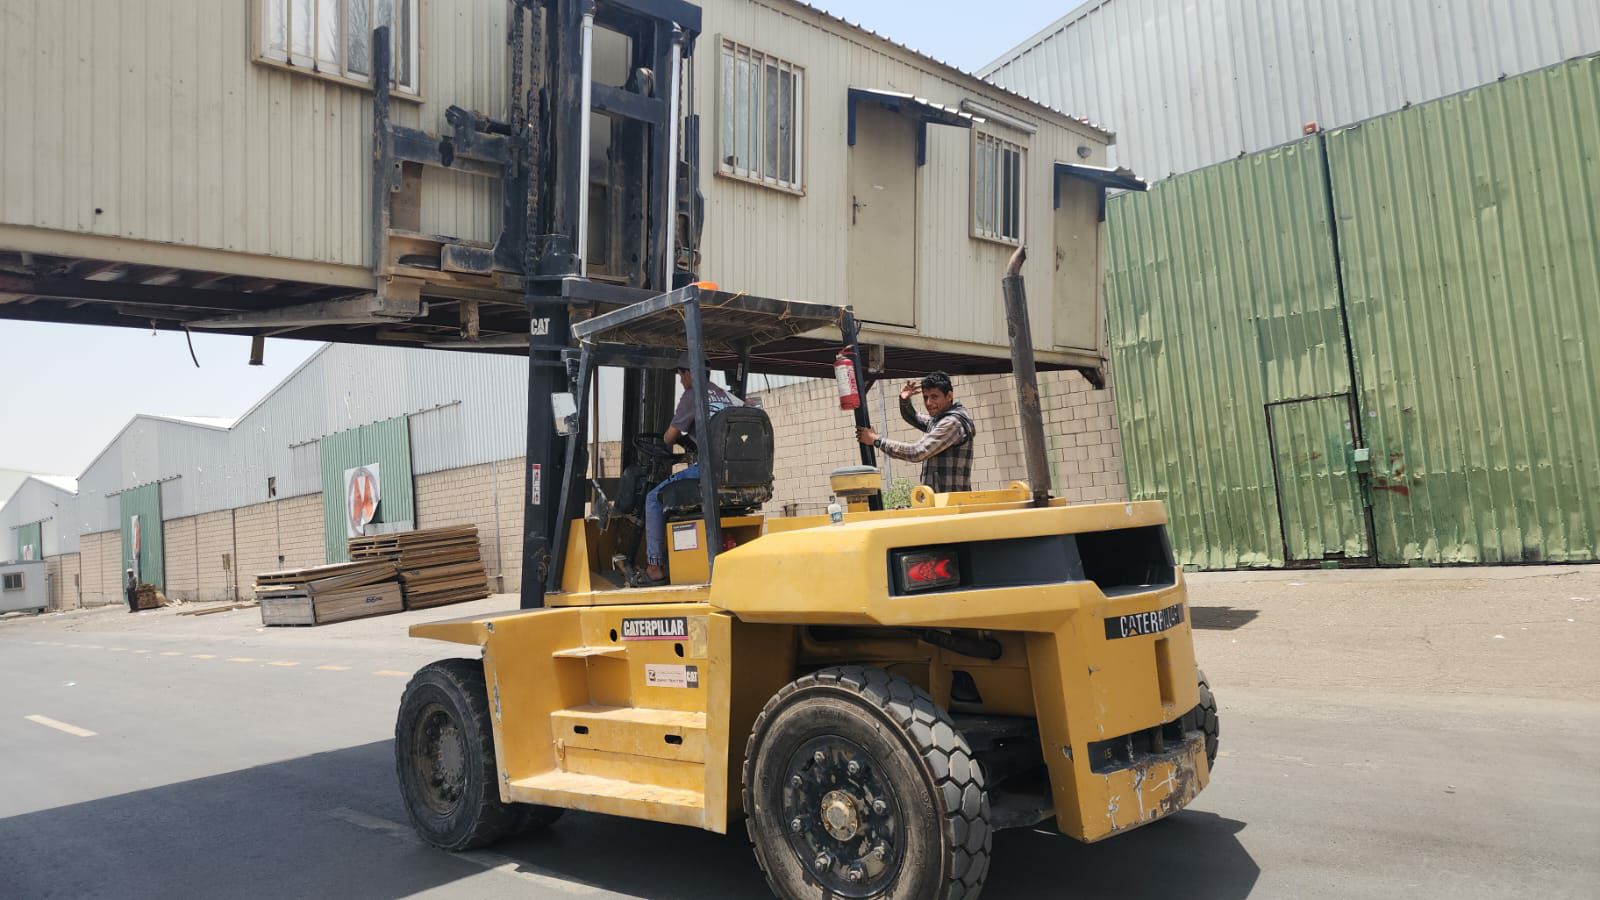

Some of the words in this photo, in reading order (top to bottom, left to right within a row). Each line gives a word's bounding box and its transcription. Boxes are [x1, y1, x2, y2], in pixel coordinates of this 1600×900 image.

[531, 317, 550, 335] CAT
[623, 619, 684, 636] CATERPILLAR
[1120, 605, 1179, 638] CATERP
[686, 671, 698, 682] CAT
